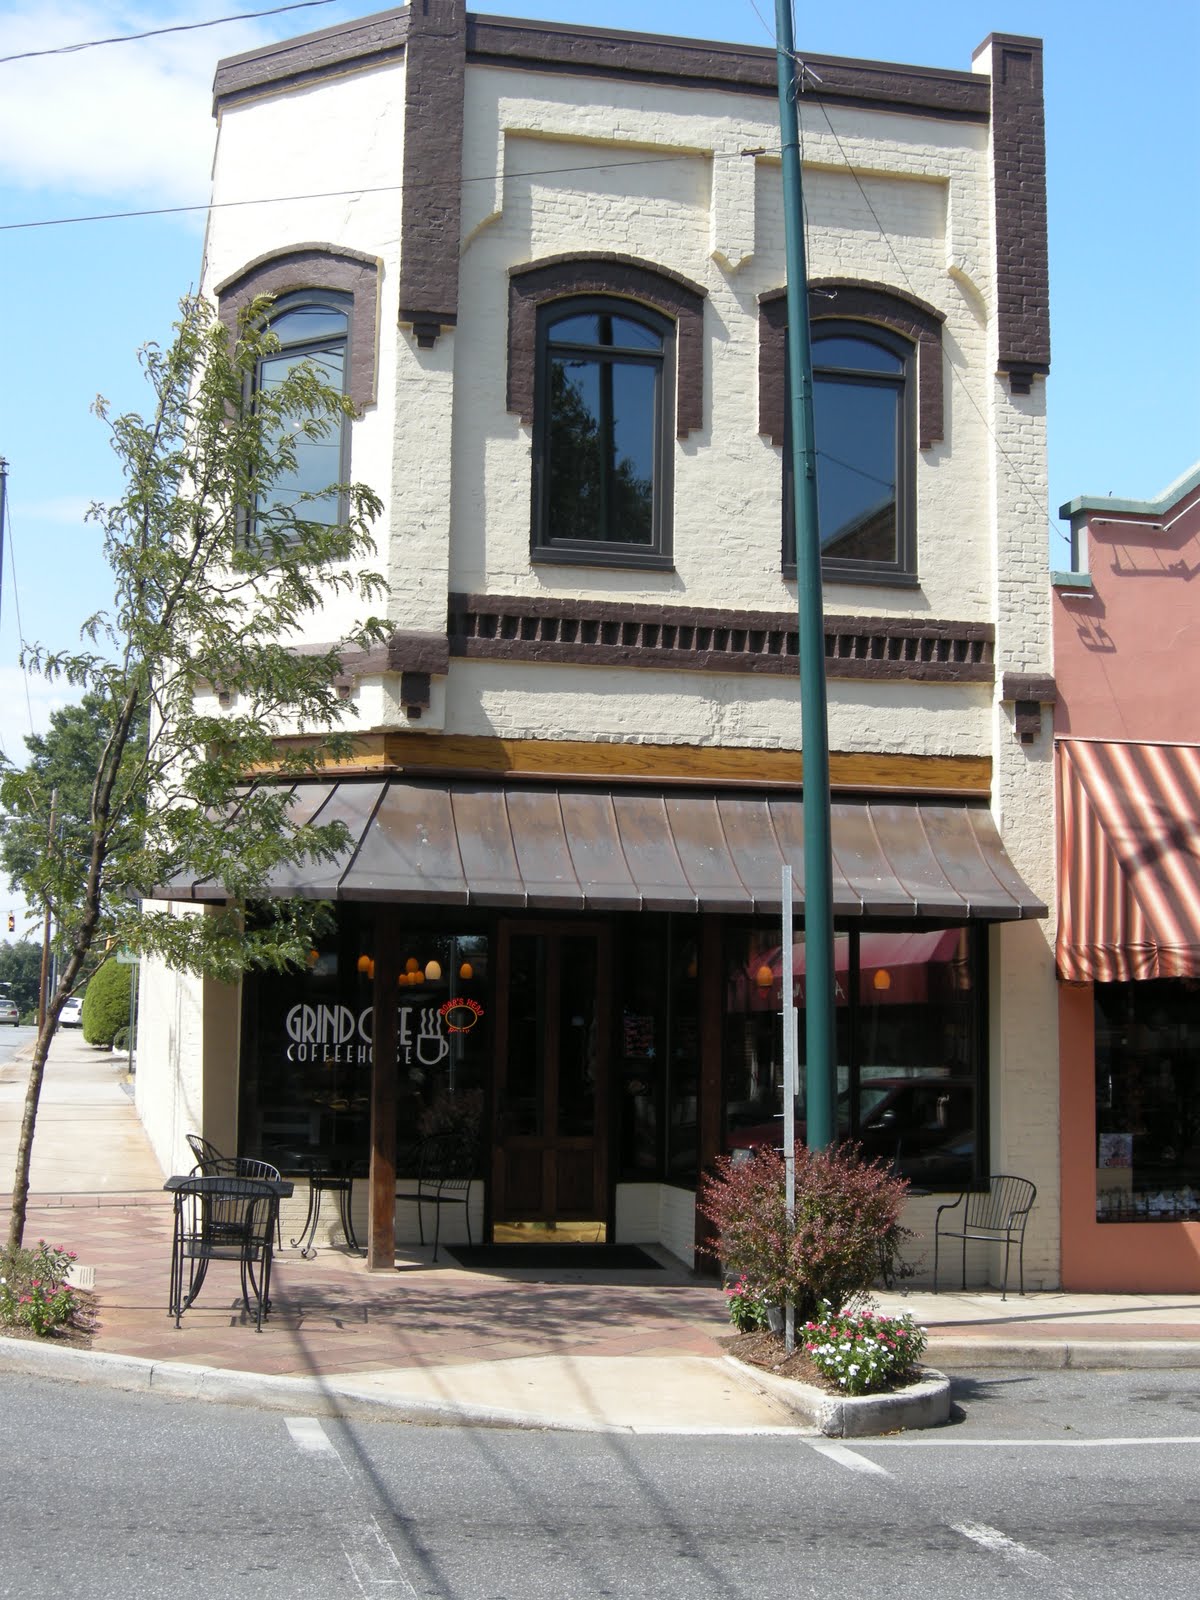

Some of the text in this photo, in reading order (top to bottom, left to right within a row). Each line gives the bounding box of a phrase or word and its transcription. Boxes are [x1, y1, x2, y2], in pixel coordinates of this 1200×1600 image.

[439, 997, 485, 1017] BOAR'S HEAD
[286, 1003, 413, 1046] GRIND CE
